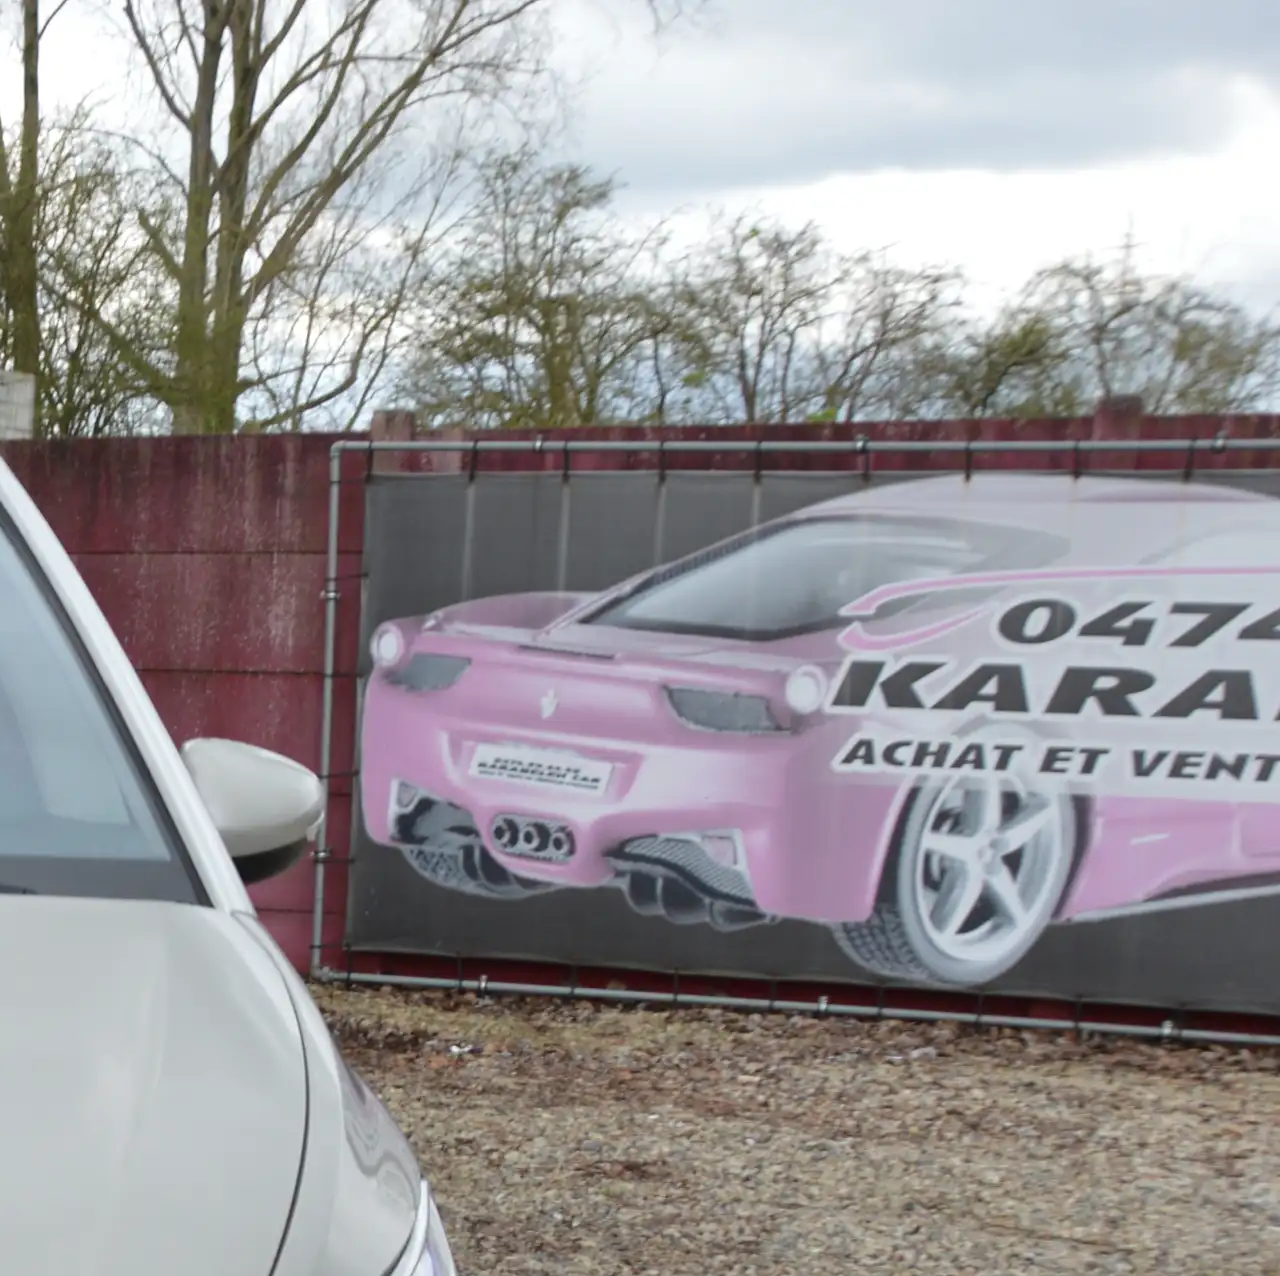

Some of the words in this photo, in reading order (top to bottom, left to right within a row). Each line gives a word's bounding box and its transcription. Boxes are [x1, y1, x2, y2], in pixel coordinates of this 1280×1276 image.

[831, 661, 1280, 720] KARA
[839, 738, 1025, 771] ACHAT
[1039, 747, 1112, 774] ET
[1131, 750, 1280, 782] VENT
